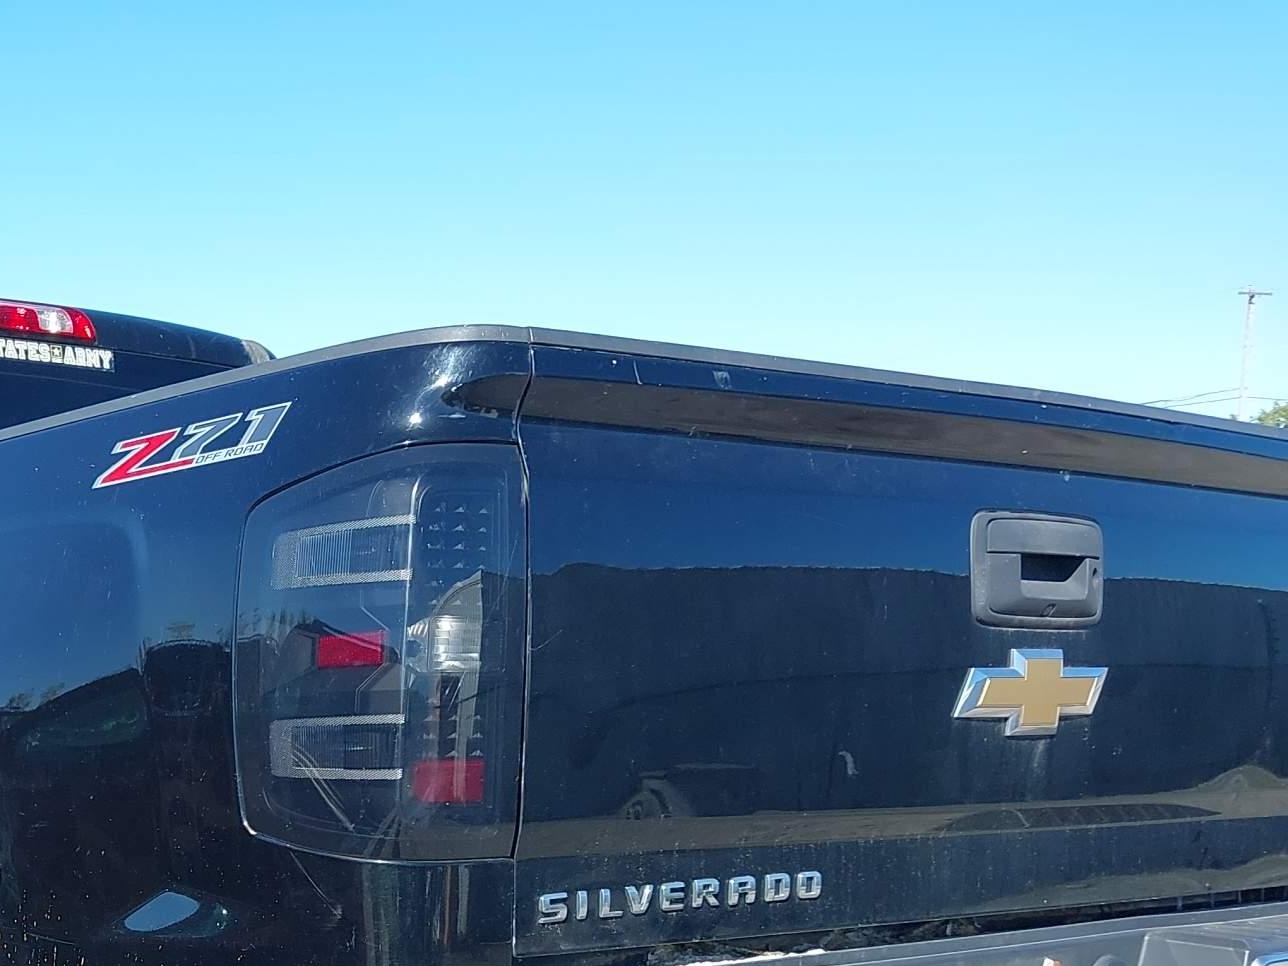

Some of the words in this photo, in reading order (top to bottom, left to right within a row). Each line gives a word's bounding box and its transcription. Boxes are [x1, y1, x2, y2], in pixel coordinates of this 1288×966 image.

[63, 345, 113, 370] ARMY
[92, 401, 293, 490] Z71
[195, 451, 225, 465] OFF
[223, 442, 265, 459] ROAD
[537, 870, 822, 924] SILVERADO
